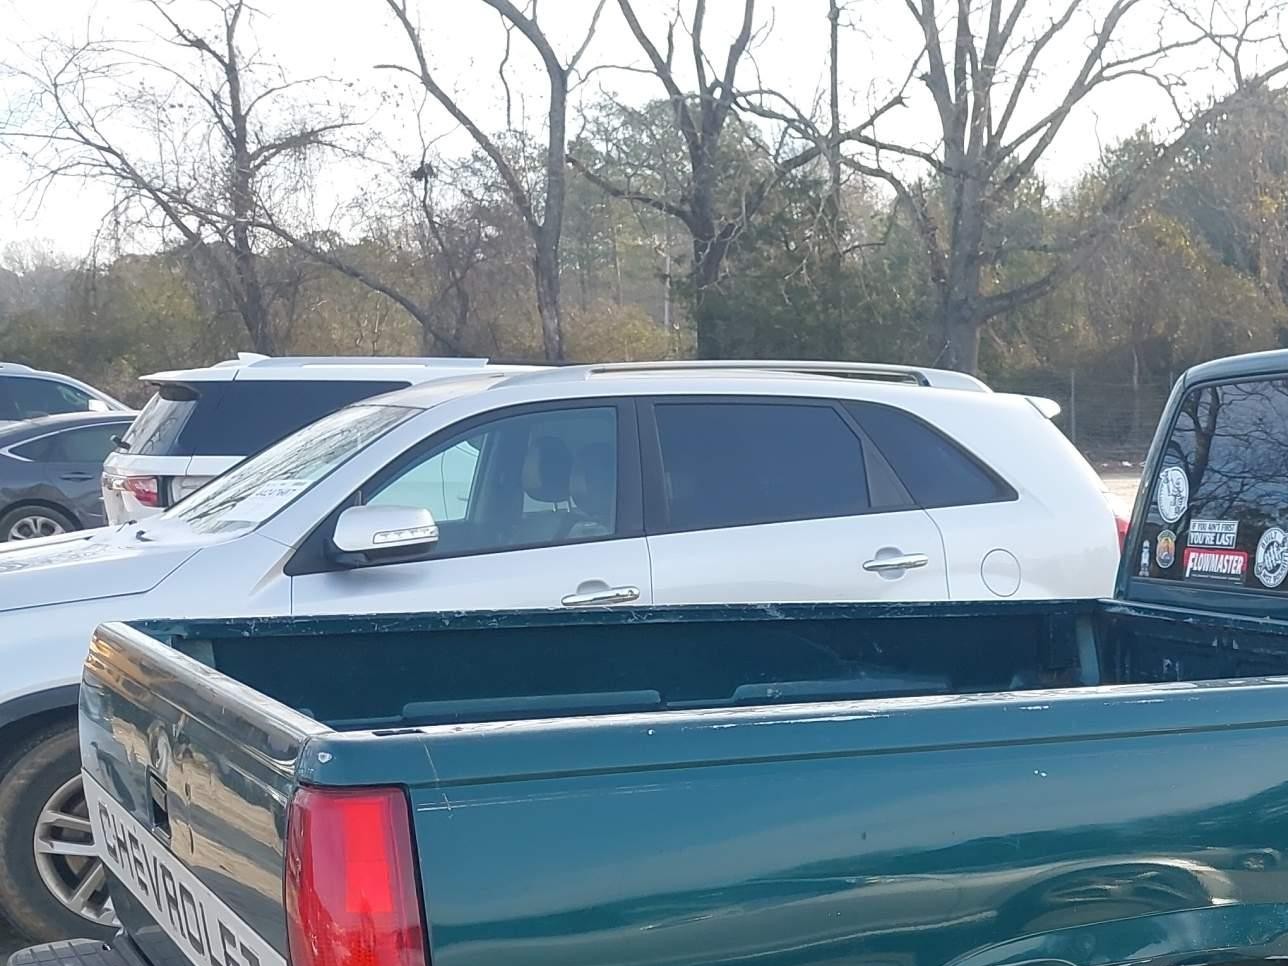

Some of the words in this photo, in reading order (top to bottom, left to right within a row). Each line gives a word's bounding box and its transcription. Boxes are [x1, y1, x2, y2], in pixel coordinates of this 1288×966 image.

[1190, 532, 1216, 545] YOU'RE
[1215, 533, 1236, 546] LAST
[1185, 551, 1244, 577] FLOWMASTER
